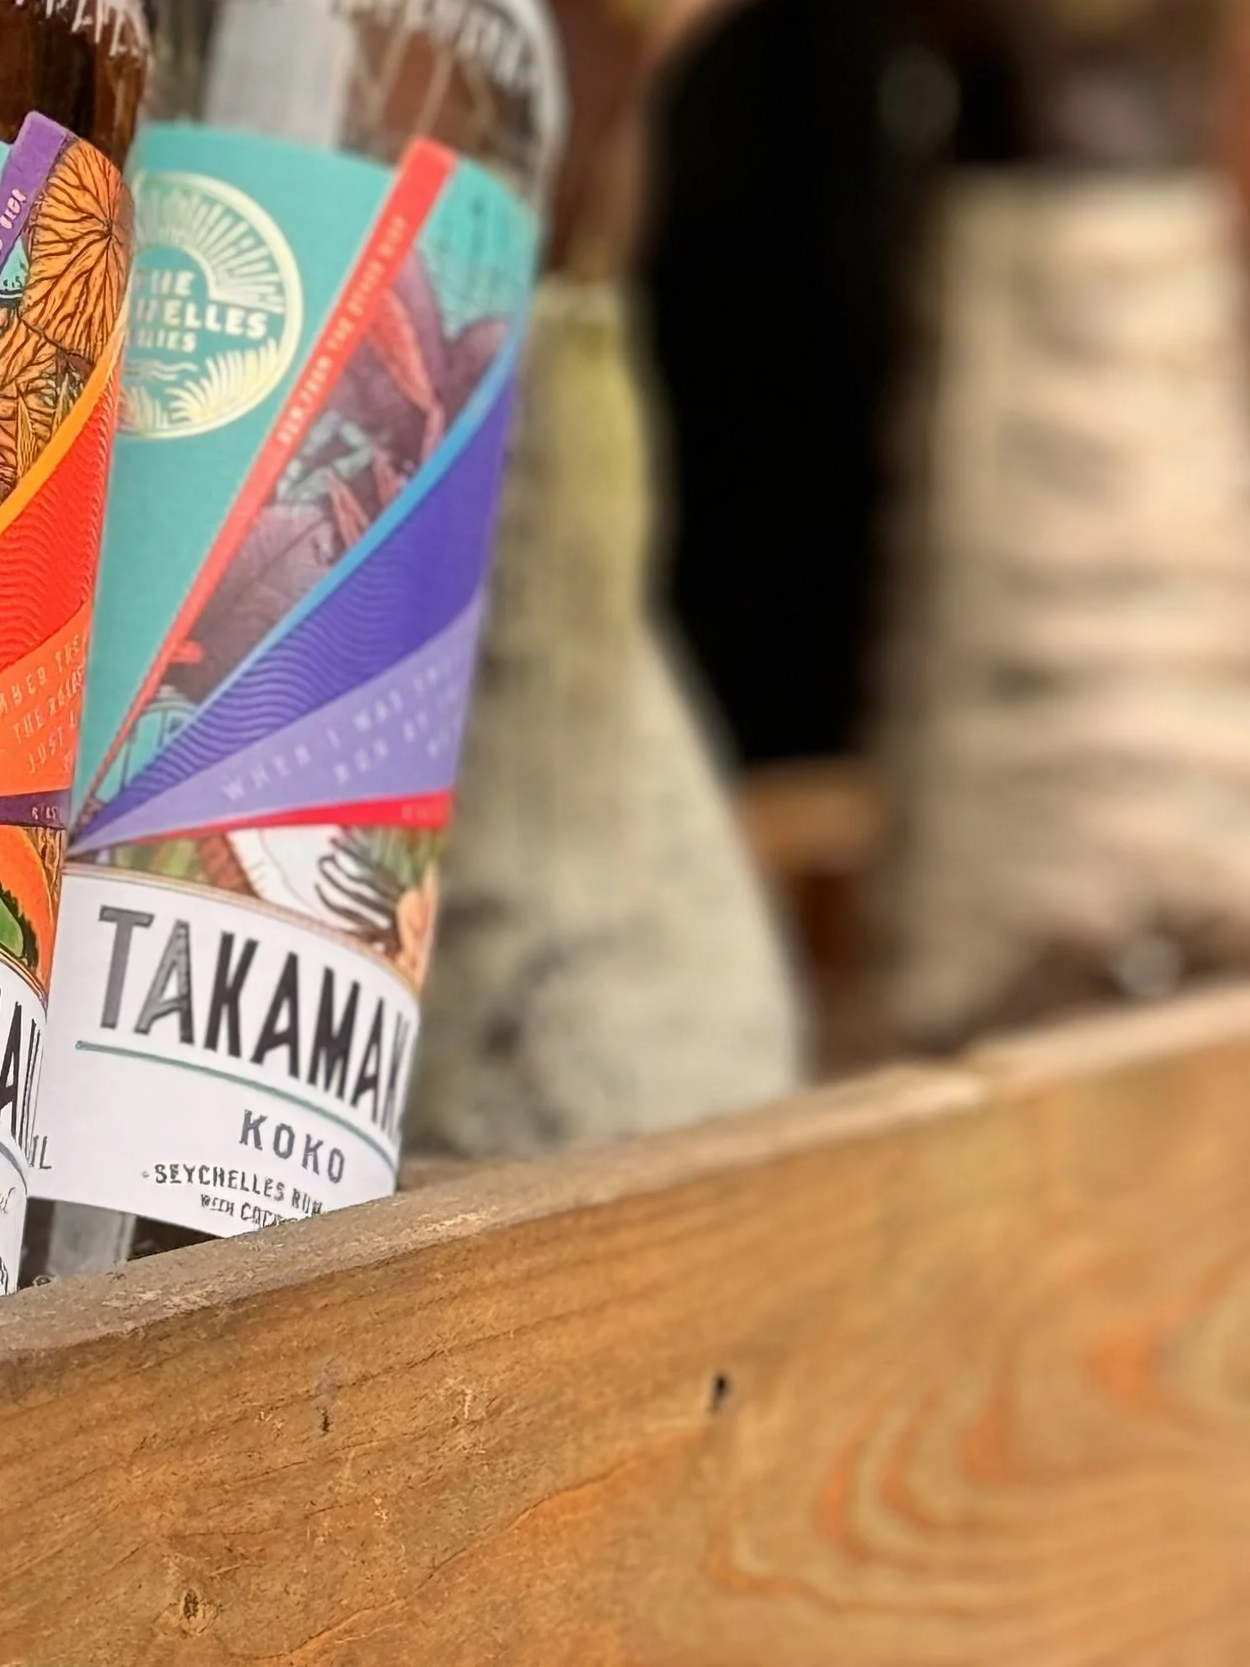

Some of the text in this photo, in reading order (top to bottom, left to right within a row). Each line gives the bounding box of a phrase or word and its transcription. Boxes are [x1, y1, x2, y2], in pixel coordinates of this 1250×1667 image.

[12, 707, 44, 746] THE
[238, 1108, 347, 1184] KOKO
[153, 1162, 287, 1203] SEYCHELLES
[200, 1192, 236, 1217] WITH
